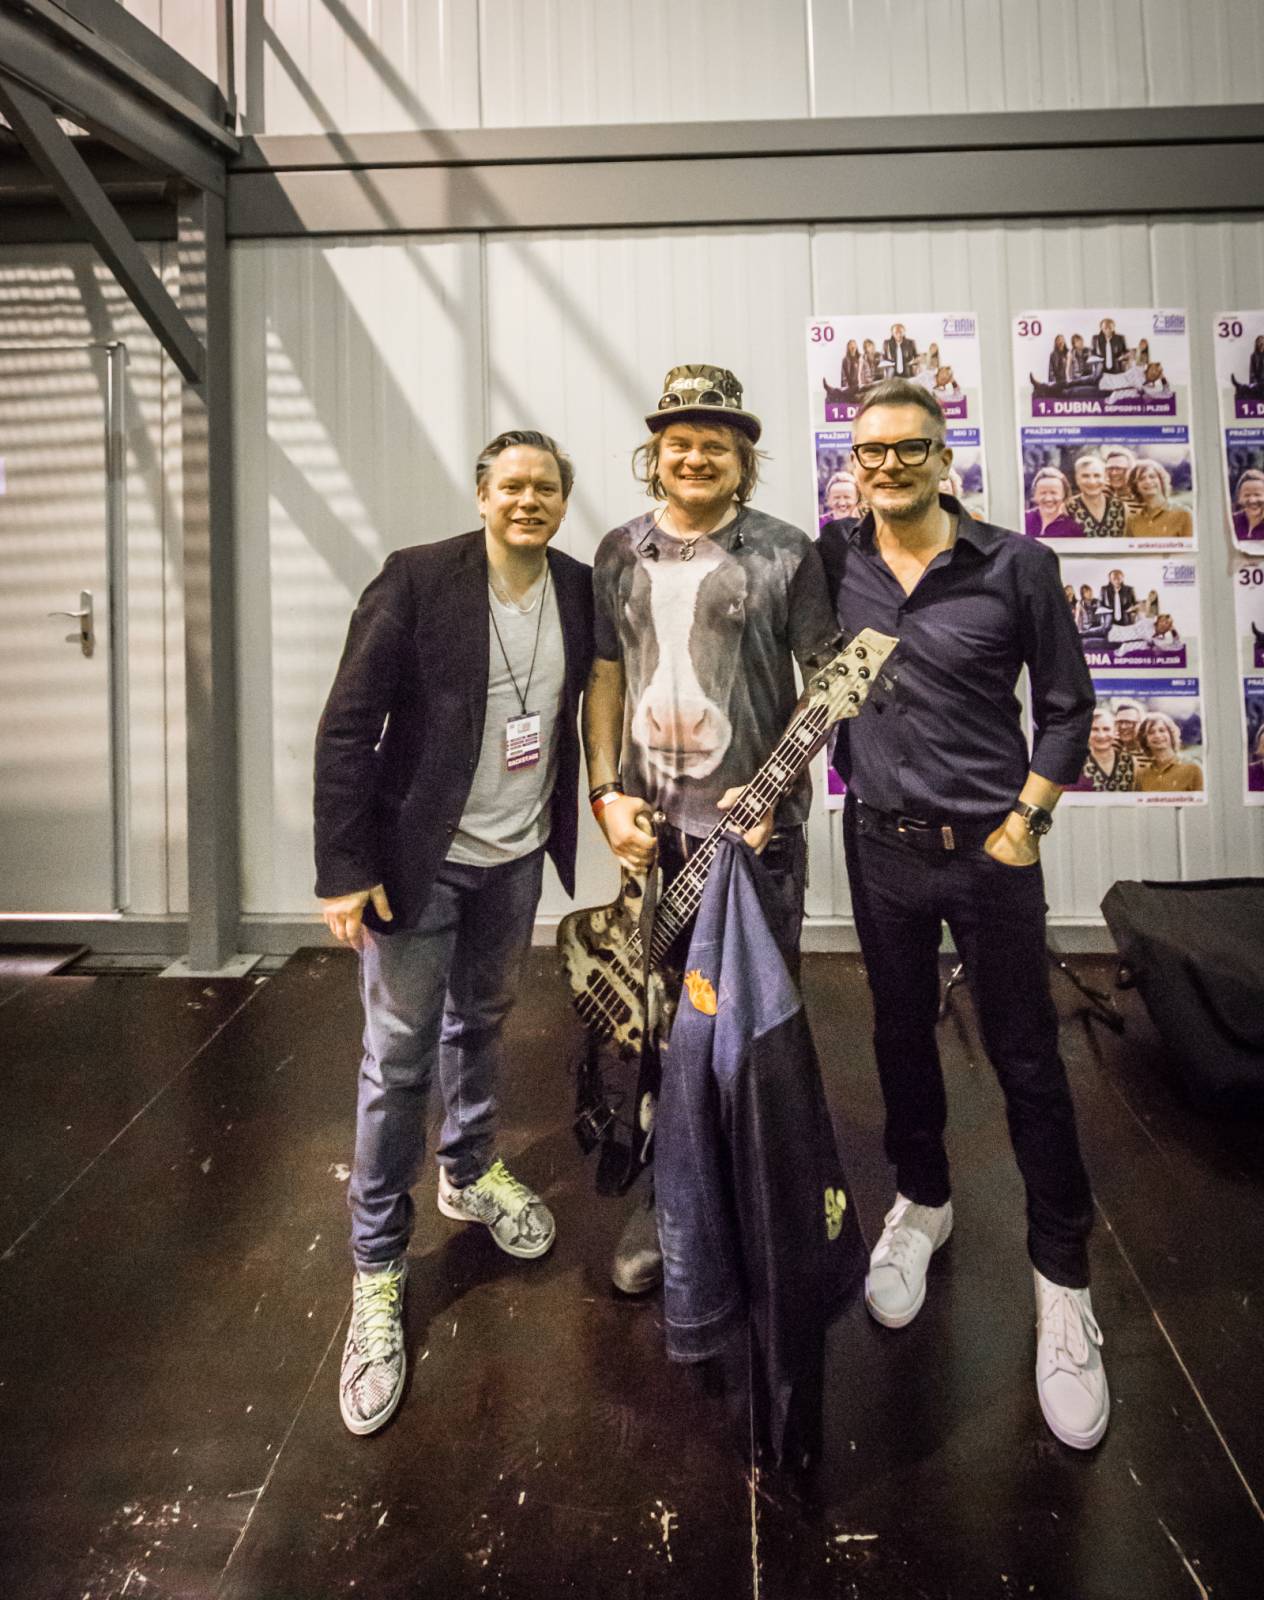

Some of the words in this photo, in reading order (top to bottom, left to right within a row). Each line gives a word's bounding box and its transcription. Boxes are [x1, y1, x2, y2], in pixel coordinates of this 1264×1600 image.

[811, 326, 835, 342] 30
[1018, 320, 1042, 337] 30
[1218, 321, 1243, 338] 30
[1038, 401, 1051, 414] 1.
[1054, 400, 1102, 414] DUBNA
[1239, 568, 1263, 586] 30
